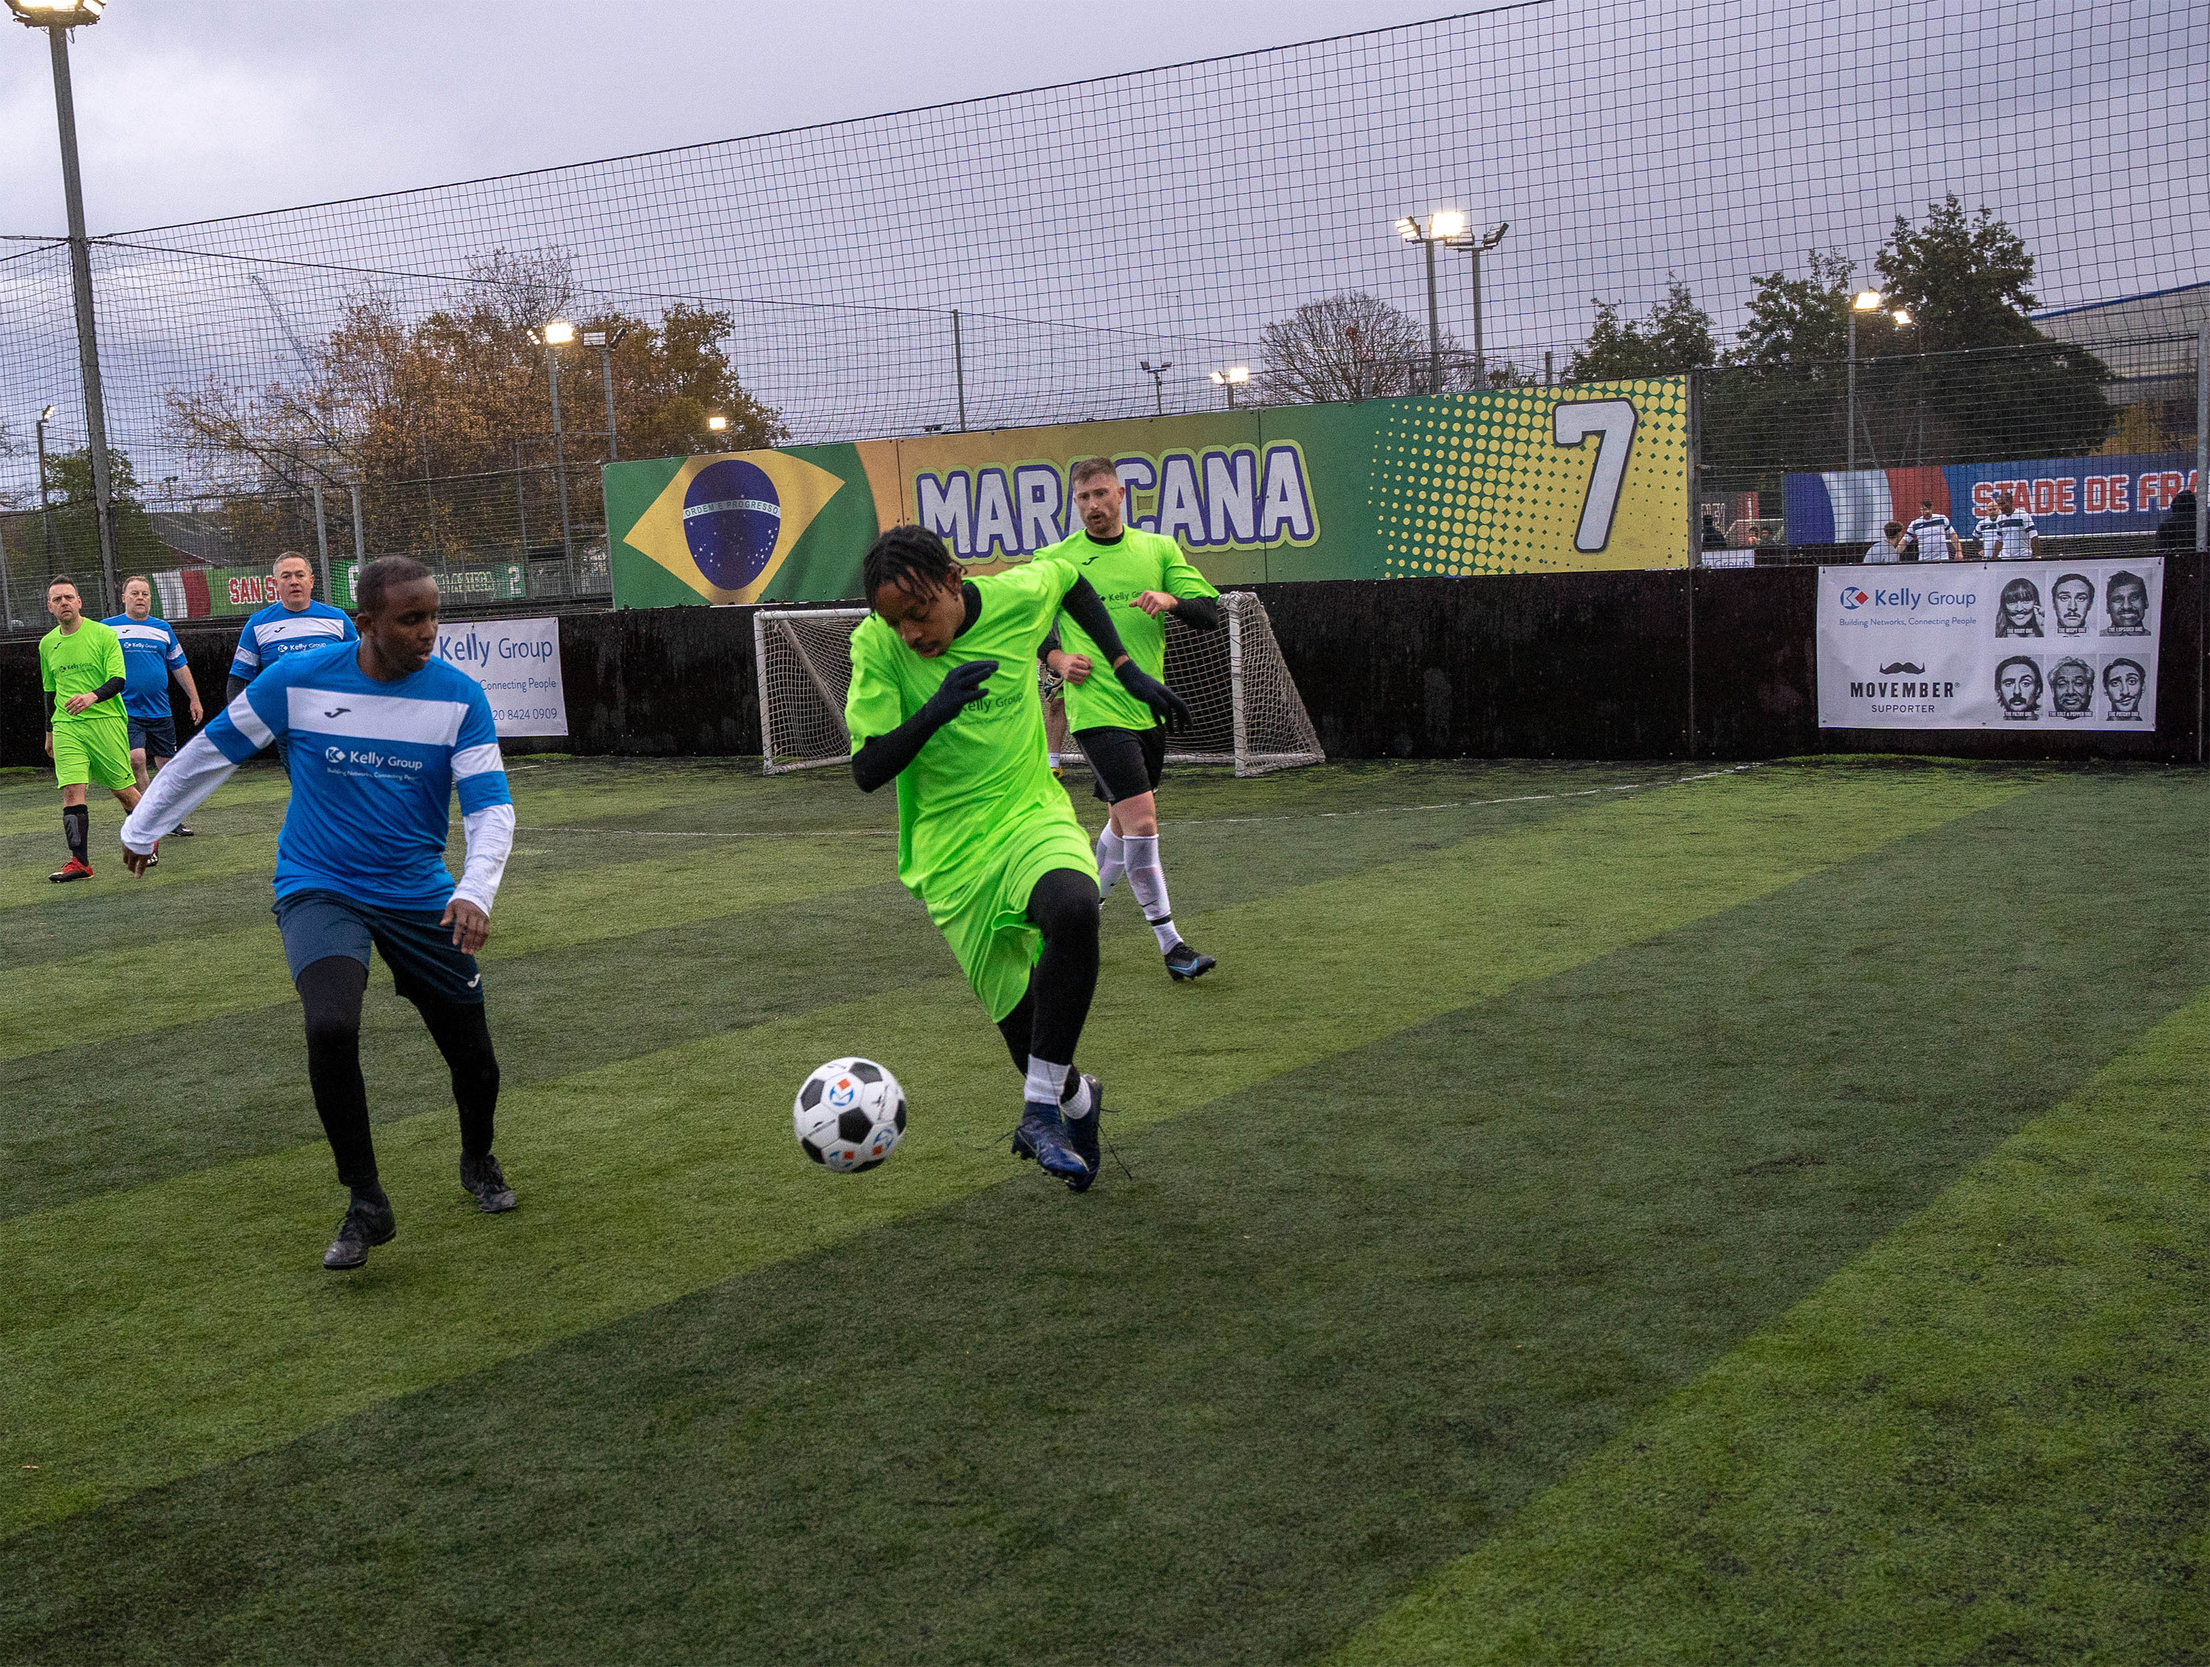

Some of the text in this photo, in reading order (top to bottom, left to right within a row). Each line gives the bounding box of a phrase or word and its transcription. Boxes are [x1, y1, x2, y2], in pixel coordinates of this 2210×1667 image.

[1552, 397, 1638, 553] 7
[915, 444, 1316, 560] MARCANA
[2084, 474, 2129, 514] DE
[684, 503, 715, 517] ORDEM
[726, 501, 779, 515] PROGRESSO
[508, 565, 521, 595] 2
[229, 576, 263, 604] SAN
[1108, 592, 1129, 601] Kelly
[1875, 588, 1977, 610] Kelly Group
[1839, 616, 1977, 628] Building Networks, Connecting People
[290, 643, 307, 651] Kelly
[439, 633, 553, 668] Kelly Group
[480, 677, 557, 693] Connecting People
[995, 692, 1024, 708] Group
[1871, 704, 1935, 713] SUPPORTER
[507, 708, 530, 720] 8424
[532, 707, 558, 719] 0909
[350, 751, 423, 771] Kelly Group
